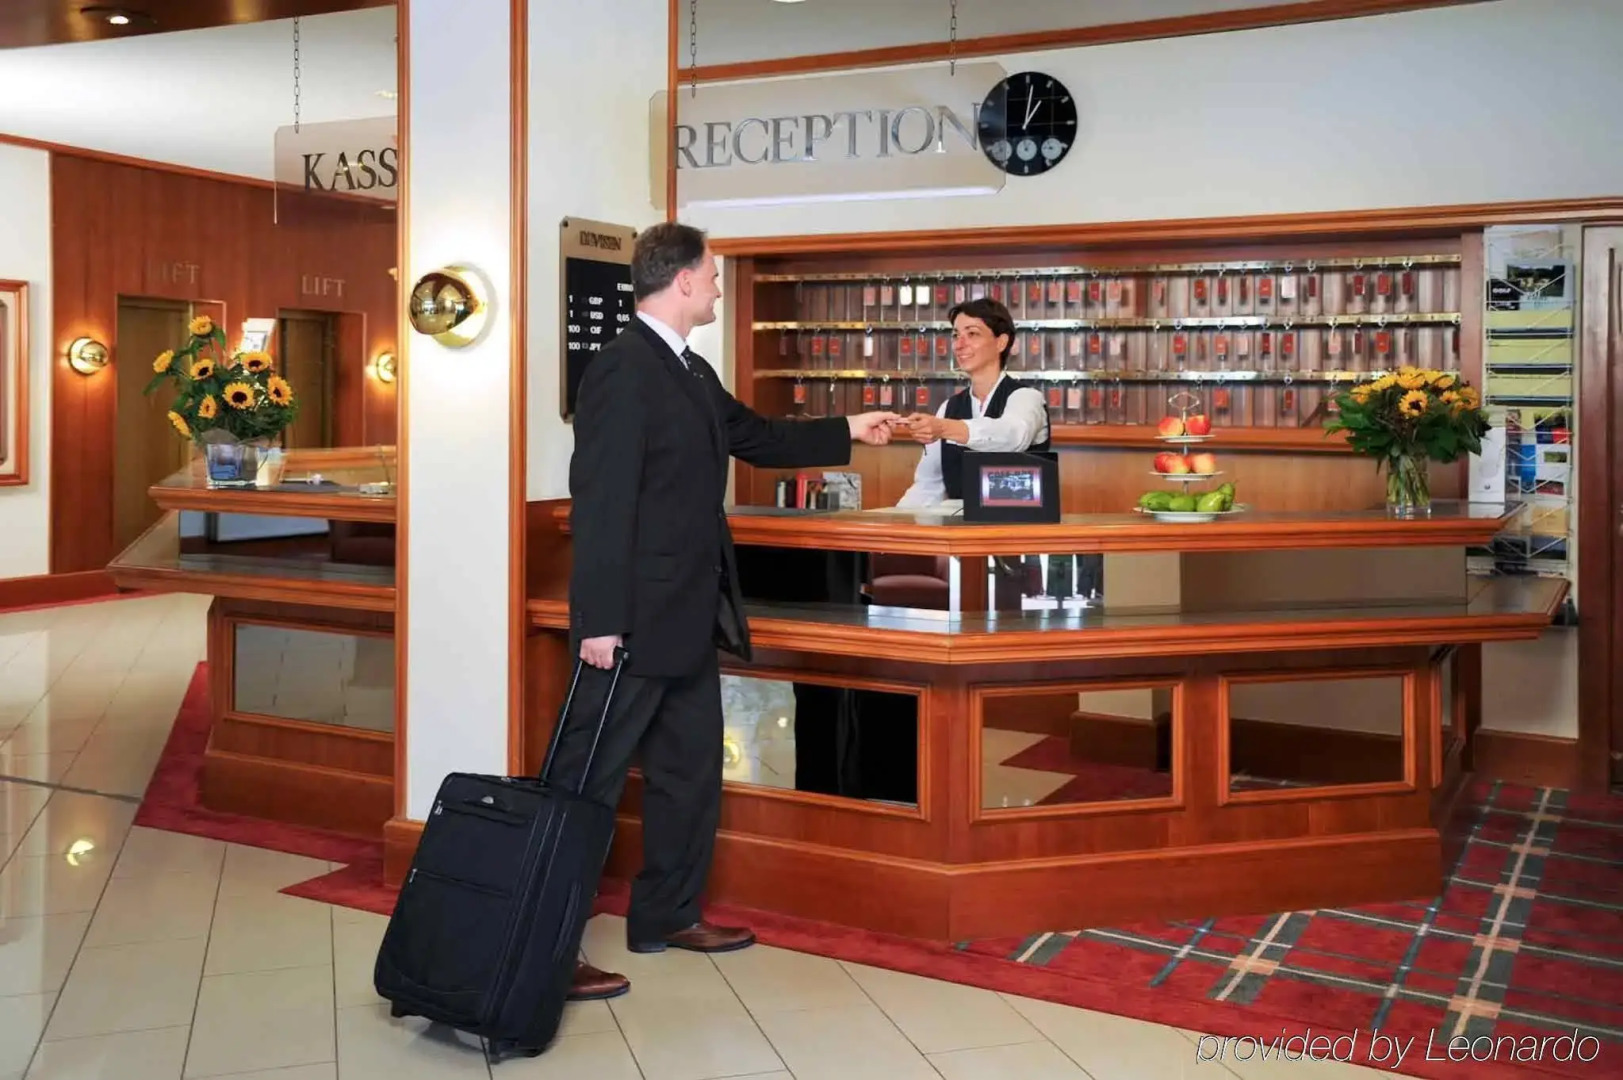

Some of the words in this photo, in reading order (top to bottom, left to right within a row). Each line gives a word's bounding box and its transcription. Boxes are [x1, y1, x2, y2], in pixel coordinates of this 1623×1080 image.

[673, 101, 982, 169] RECEPTION
[301, 147, 398, 193] KASS
[302, 274, 347, 297] LIFT
[568, 325, 581, 334] 100
[568, 342, 581, 351] 100
